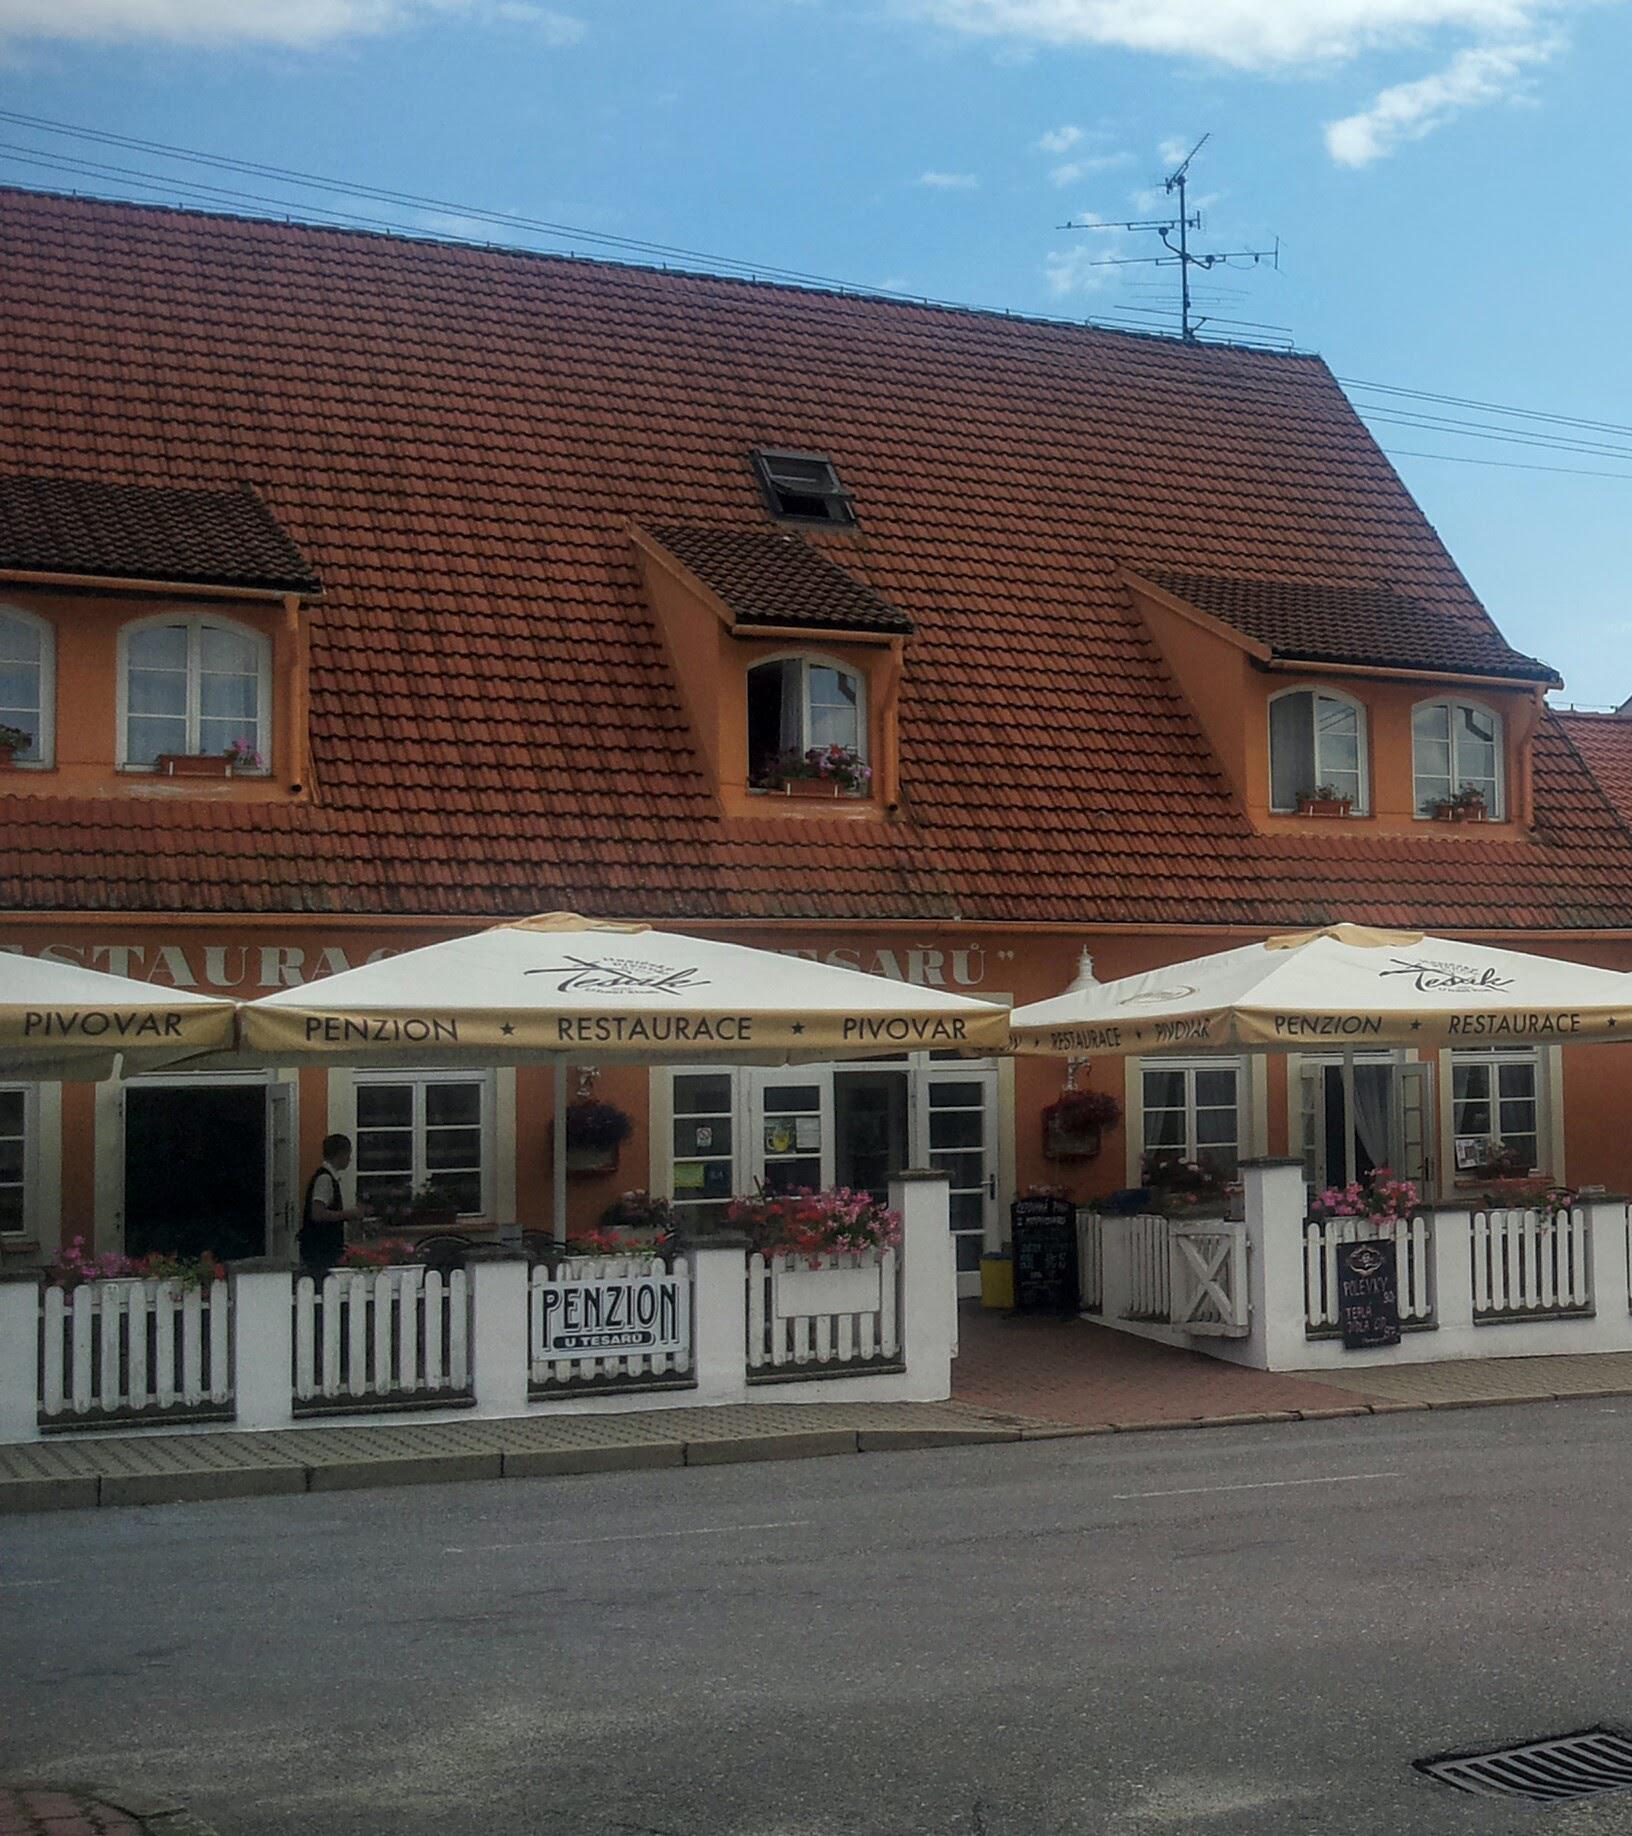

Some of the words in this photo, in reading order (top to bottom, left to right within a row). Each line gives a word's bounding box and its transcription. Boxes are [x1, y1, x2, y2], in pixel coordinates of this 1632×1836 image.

[24, 1012, 183, 1037] PIVOVAR
[305, 1016, 459, 1042] PENZION
[557, 1016, 753, 1041] RESTAURACE
[843, 1017, 967, 1040] PIVOVAR
[1274, 1014, 1383, 1036] PENZION
[1448, 1013, 1581, 1035] RESTAURACE
[1050, 1026, 1122, 1051] RESTAURACE
[542, 1283, 680, 1352] PENZION
[564, 1337, 577, 1348] U
